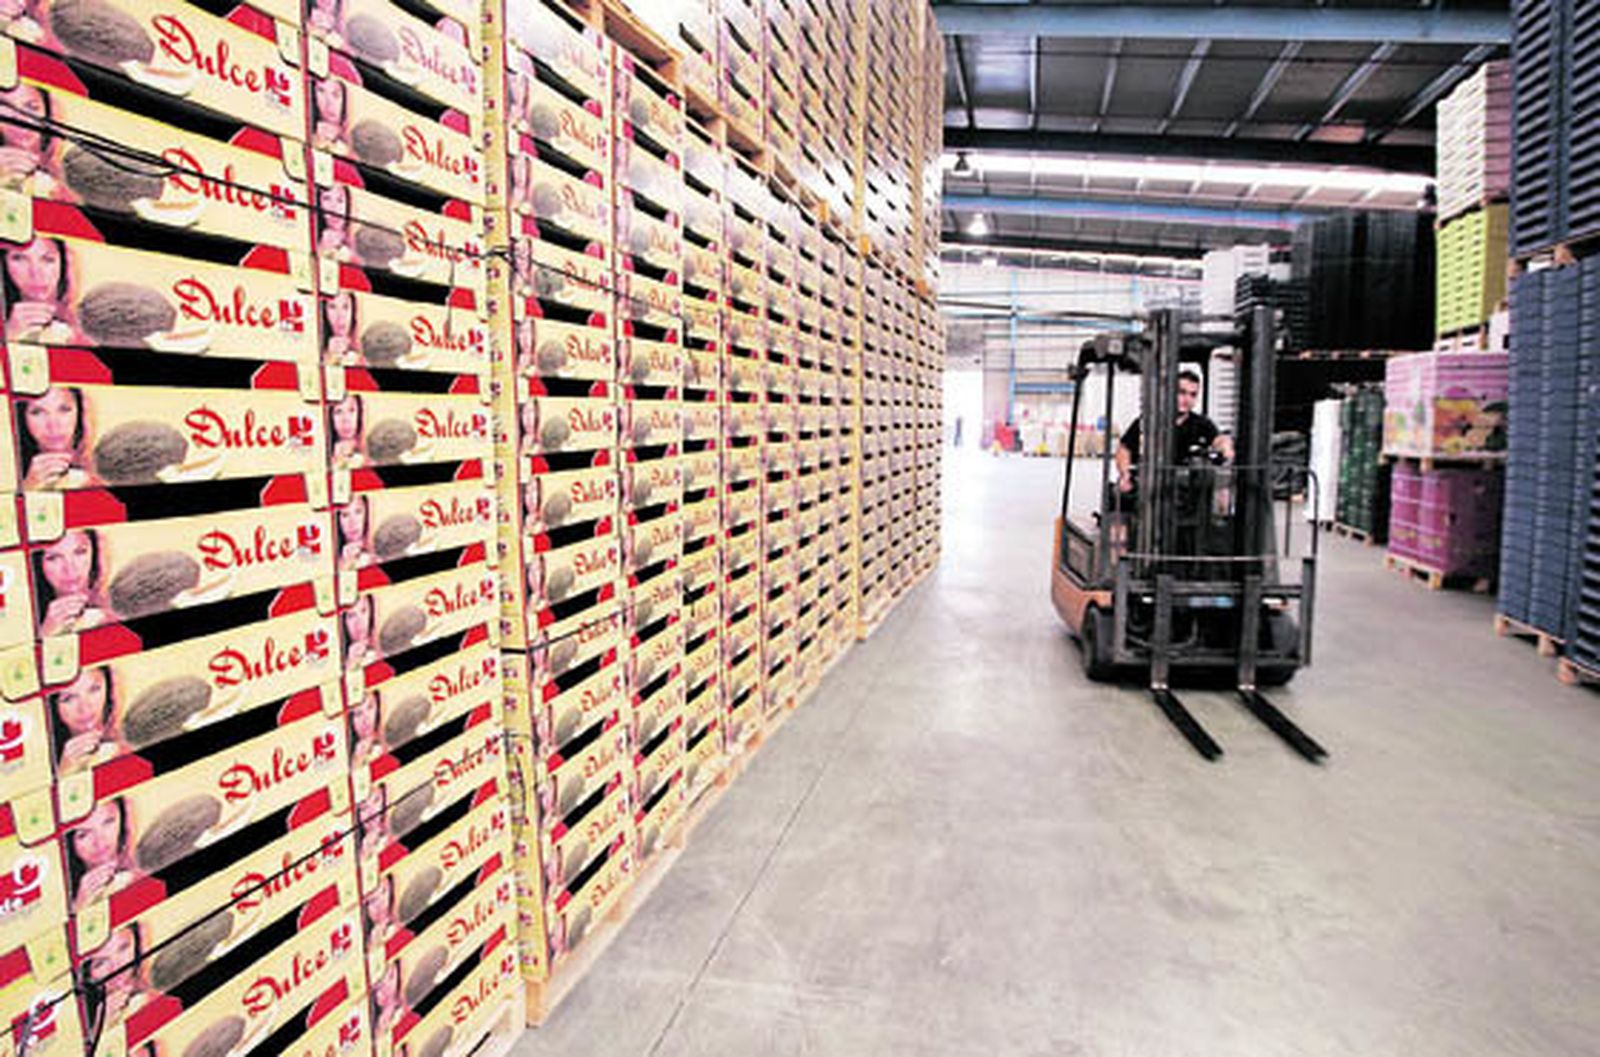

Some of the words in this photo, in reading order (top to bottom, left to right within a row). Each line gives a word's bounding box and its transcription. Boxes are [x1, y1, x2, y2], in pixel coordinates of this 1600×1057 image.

[151, 15, 262, 92] Dulce
[402, 125, 460, 176] Dulce
[162, 147, 268, 212] Dulce
[173, 278, 275, 329] Dulce
[185, 404, 285, 448] Dulce
[415, 407, 472, 438] Dulce
[420, 497, 477, 530] Dulce
[198, 530, 293, 571] Dulce
[426, 585, 481, 617] Dulce
[208, 643, 302, 690] Dulce
[428, 668, 483, 703] Dulce
[218, 751, 311, 803] Dulce
[433, 747, 488, 787] Dulce
[230, 852, 317, 914] Dulce
[445, 902, 497, 947] Dulce
[242, 951, 328, 1017] Dulce
[451, 973, 501, 1025] Dulce
